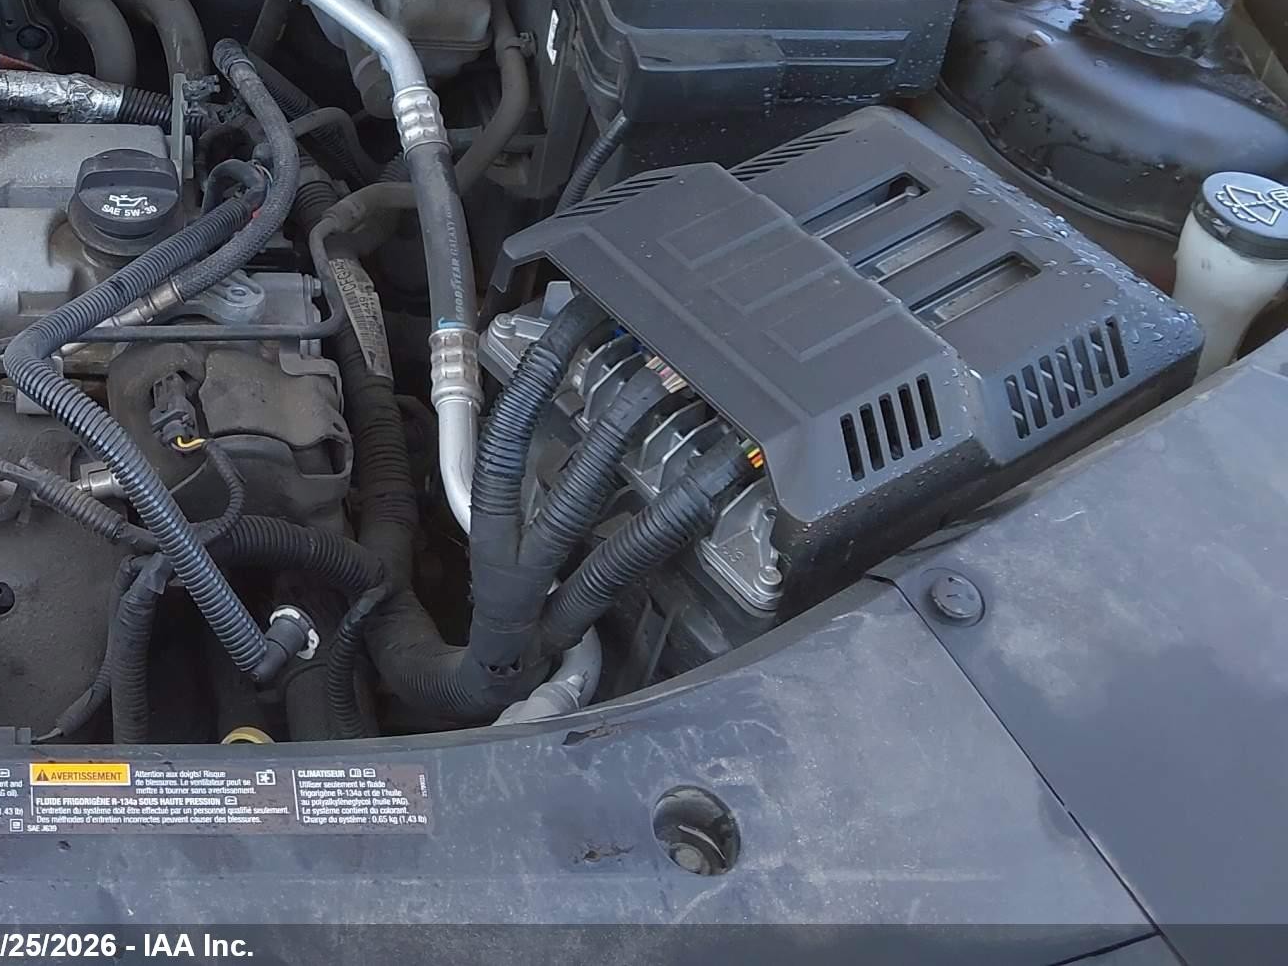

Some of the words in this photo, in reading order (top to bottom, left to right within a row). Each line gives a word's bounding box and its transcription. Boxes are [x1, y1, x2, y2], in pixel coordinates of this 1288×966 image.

[101, 204, 121, 216] SAE
[124, 205, 158, 217] 5W-30
[450, 258, 465, 321] GOODYEAR
[50, 771, 123, 781] AVERTISSEMENT
[134, 770, 165, 778] Attention
[165, 770, 178, 778] aux
[179, 770, 202, 779] doigts!
[203, 770, 226, 779] Risque
[297, 769, 346, 777] CLIMATISEUR
[226, 779, 241, 787] peut
[298, 780, 322, 788] Utiliser
[323, 780, 358, 788] seulement
[359, 780, 366, 788] le
[366, 780, 386, 788] fluide
[300, 789, 336, 798] frigorigène
[337, 789, 362, 797] R-134a
[363, 789, 371, 797] et
[371, 789, 381, 797] de
[381, 789, 402, 797] l'huile
[36, 797, 61, 805] FLUIDE
[62, 795, 110, 805] FRIGORIGÈNE
[111, 797, 137, 805] R-134a
[138, 797, 159, 805] SOUS
[159, 797, 184, 805] HAUTE
[184, 797, 221, 805] PRESSION
[372, 798, 391, 806] (huile
[36, 806, 71, 814] L'entretien
[72, 806, 82, 814] du
[83, 806, 111, 815] système
[112, 806, 125, 814] doit
[126, 806, 140, 814] être
[141, 806, 169, 814] effectué
[170, 807, 182, 815] par
[183, 806, 192, 814] un
[193, 807, 226, 815] personnel
[227, 806, 252, 815] qualifié
[311, 807, 340, 816] système
[36, 815, 50, 823] Des
[51, 815, 84, 823] méthodes
[85, 815, 122, 823] d'entretien
[123, 815, 160, 823] incorrectes
[161, 816, 189, 824] peuvent
[189, 815, 213, 823] causer
[213, 815, 227, 823] des
[227, 815, 262, 823] blessures.
[303, 816, 327, 824] Charge
[338, 815, 367, 824] système
[388, 816, 398, 824] kg
[417, 815, 427, 824] lb)
[26, 824, 41, 832] SAE
